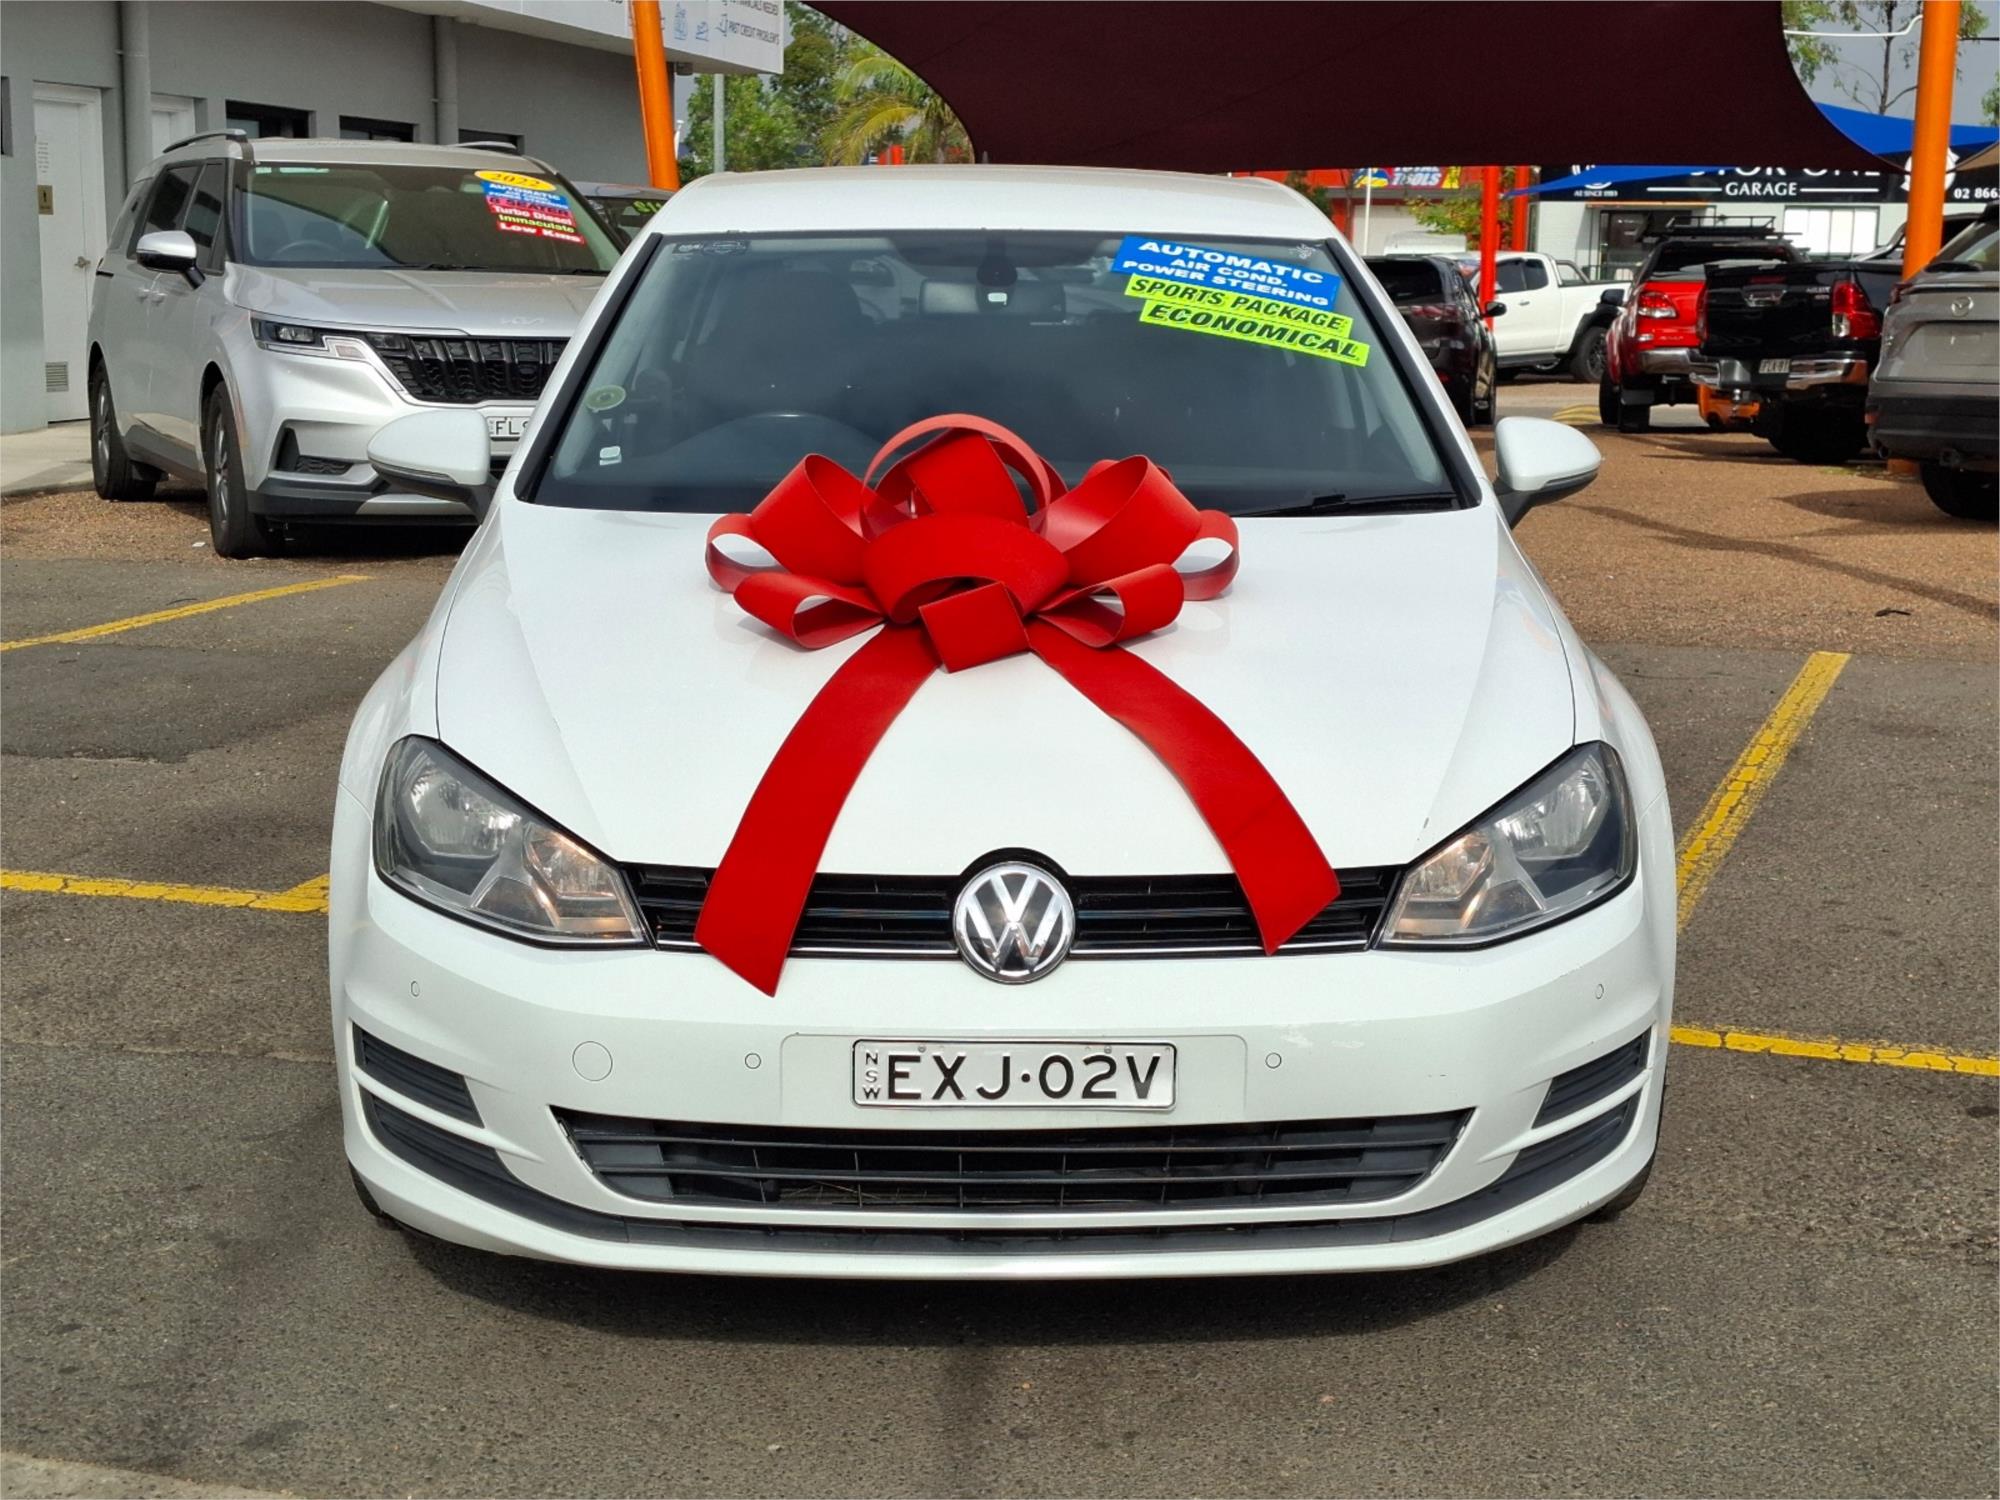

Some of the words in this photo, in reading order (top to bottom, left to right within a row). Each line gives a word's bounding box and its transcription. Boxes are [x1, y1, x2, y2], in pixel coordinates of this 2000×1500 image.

[1725, 182, 1797, 196] GARAGE
[1953, 187, 1970, 199] 02
[1974, 187, 2000, 199] 866
[494, 205, 531, 218] Turbo
[533, 211, 573, 226] Diesel
[499, 214, 575, 233] Immaculate
[500, 222, 537, 234] Low
[541, 228, 581, 242] Kms
[1138, 241, 1324, 284] AUTOMATIC
[1170, 258, 1211, 273] AIR
[1217, 264, 1288, 287] COND.
[1122, 260, 1205, 281] POWER
[1211, 275, 1329, 306] STEERING
[1131, 277, 1226, 306] SPORTS
[1230, 295, 1345, 331] PACKAGE
[1146, 303, 1360, 359] ECONOMICAL
